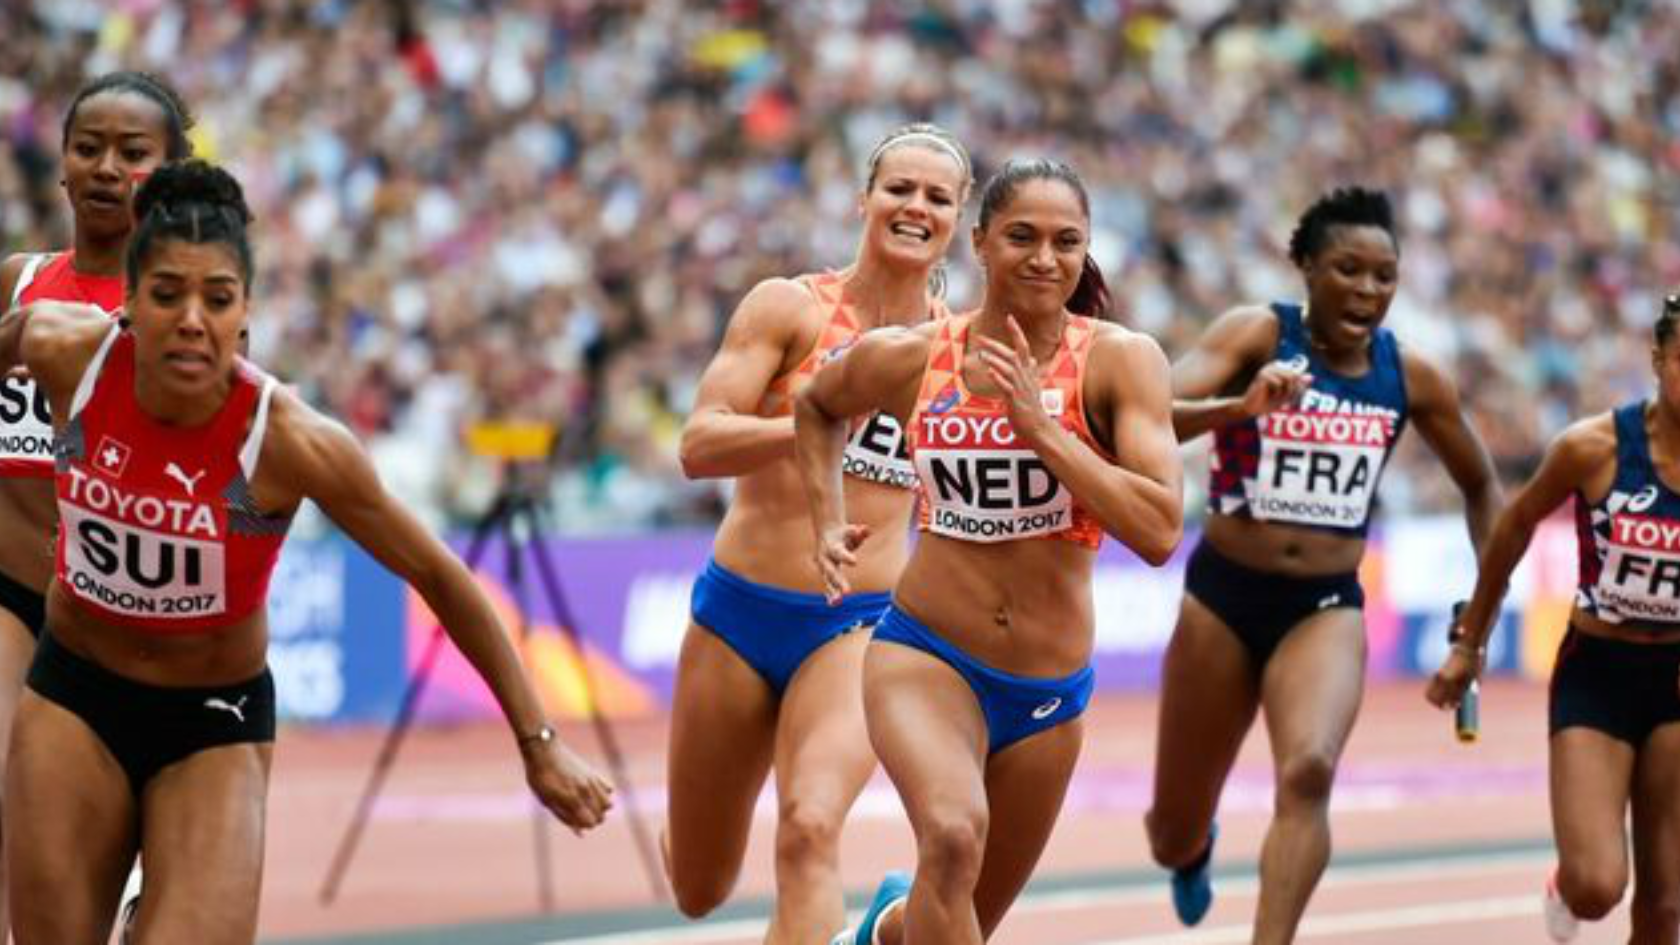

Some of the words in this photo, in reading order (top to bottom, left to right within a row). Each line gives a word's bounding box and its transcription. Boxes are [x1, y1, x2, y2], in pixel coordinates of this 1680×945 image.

[1270, 412, 1385, 444] TOYOTA
[930, 457, 1060, 510] NED
[1272, 448, 1369, 496] FRA
[69, 464, 218, 538] TOYOTA
[935, 510, 1014, 537] LONDON
[1018, 511, 1066, 533] 2017
[1260, 497, 1337, 518] LONDON
[77, 519, 201, 589] SUI
[1615, 552, 1680, 599] FR
[67, 566, 157, 613] ONDON
[161, 594, 216, 613] 2017
